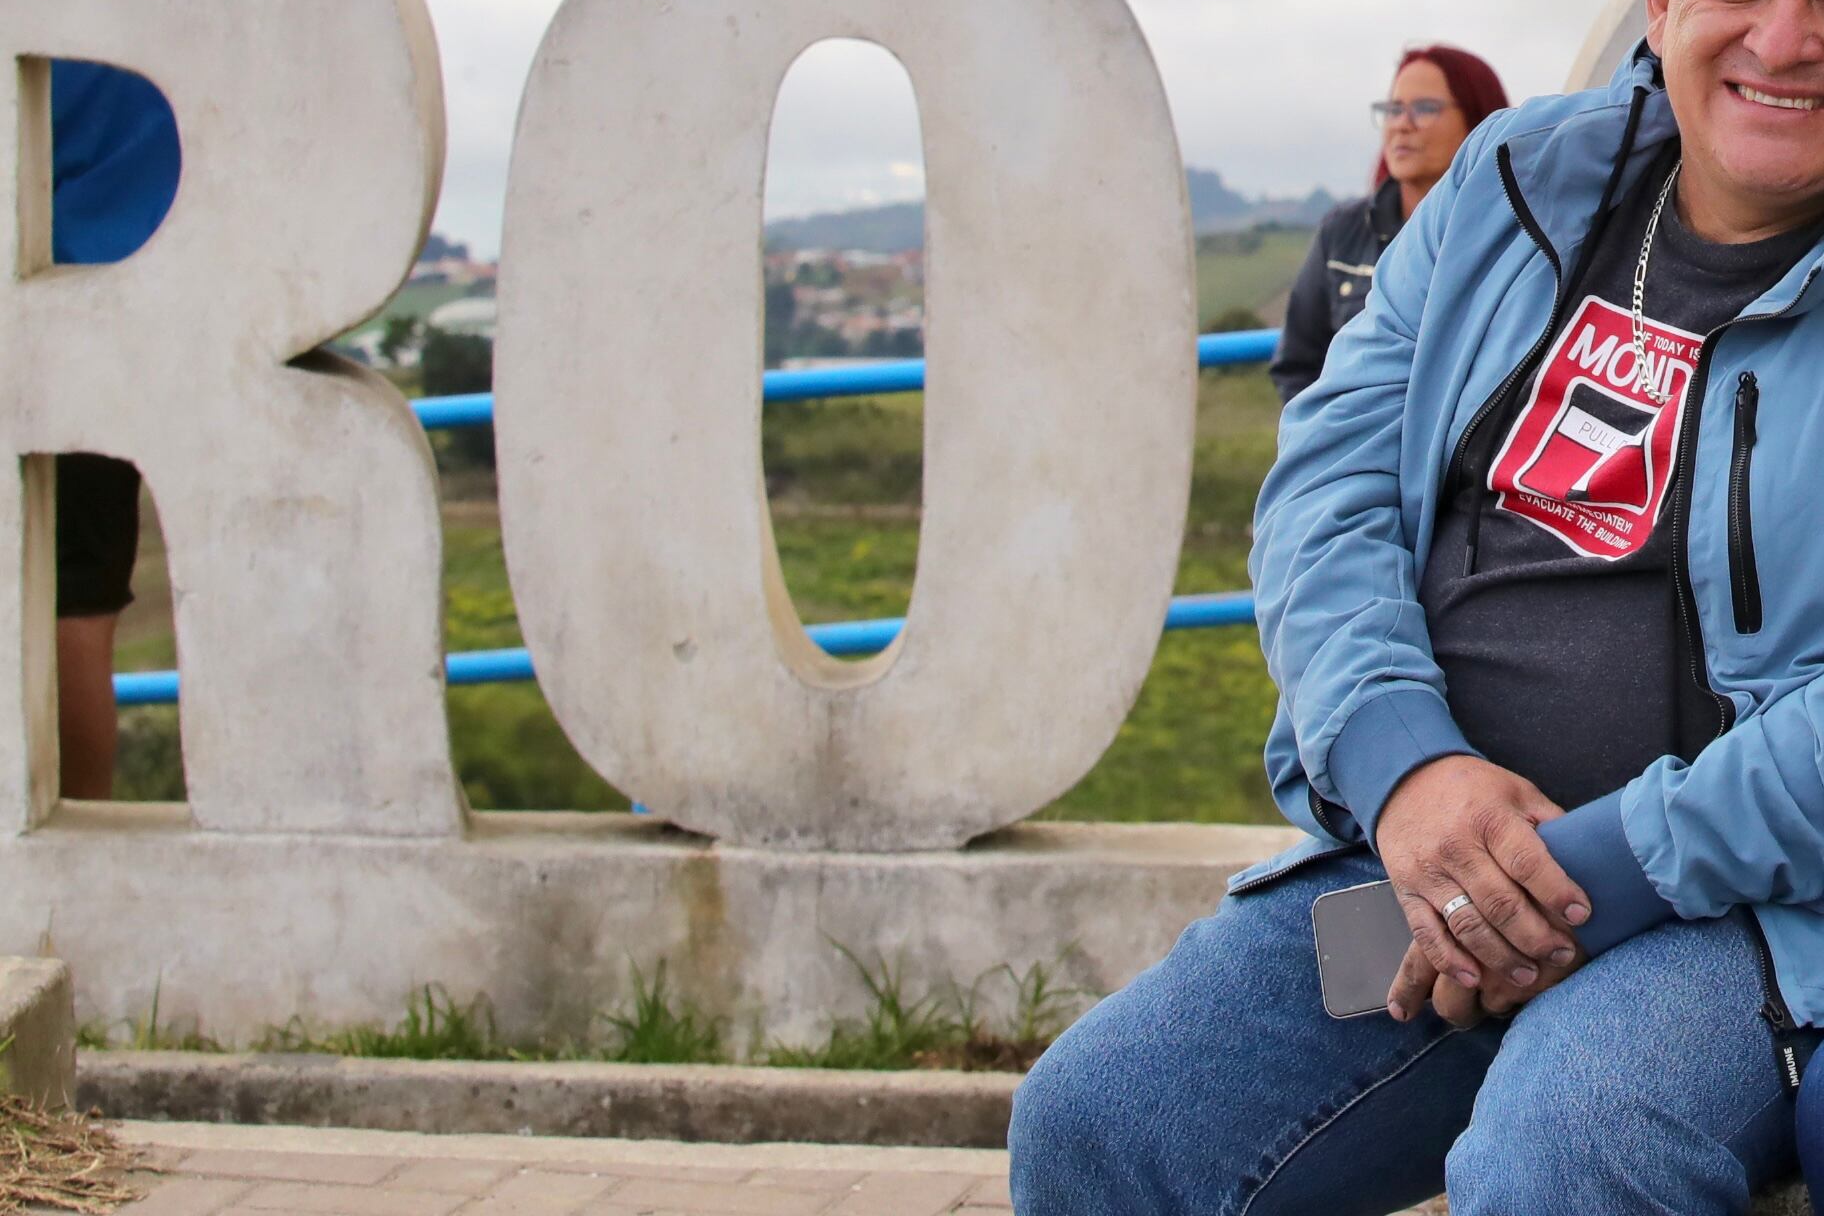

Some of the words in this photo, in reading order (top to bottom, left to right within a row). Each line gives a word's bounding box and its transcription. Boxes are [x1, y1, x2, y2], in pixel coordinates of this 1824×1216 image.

[1653, 335, 1686, 356] TODAY
[1688, 346, 1701, 361] IS
[1578, 420, 1616, 450] PULL
[1518, 494, 1576, 522] EVACUATE
[1576, 514, 1597, 534] THE
[1594, 526, 1632, 550] BUILDING
[1783, 1046, 1800, 1087] IMMUNE
